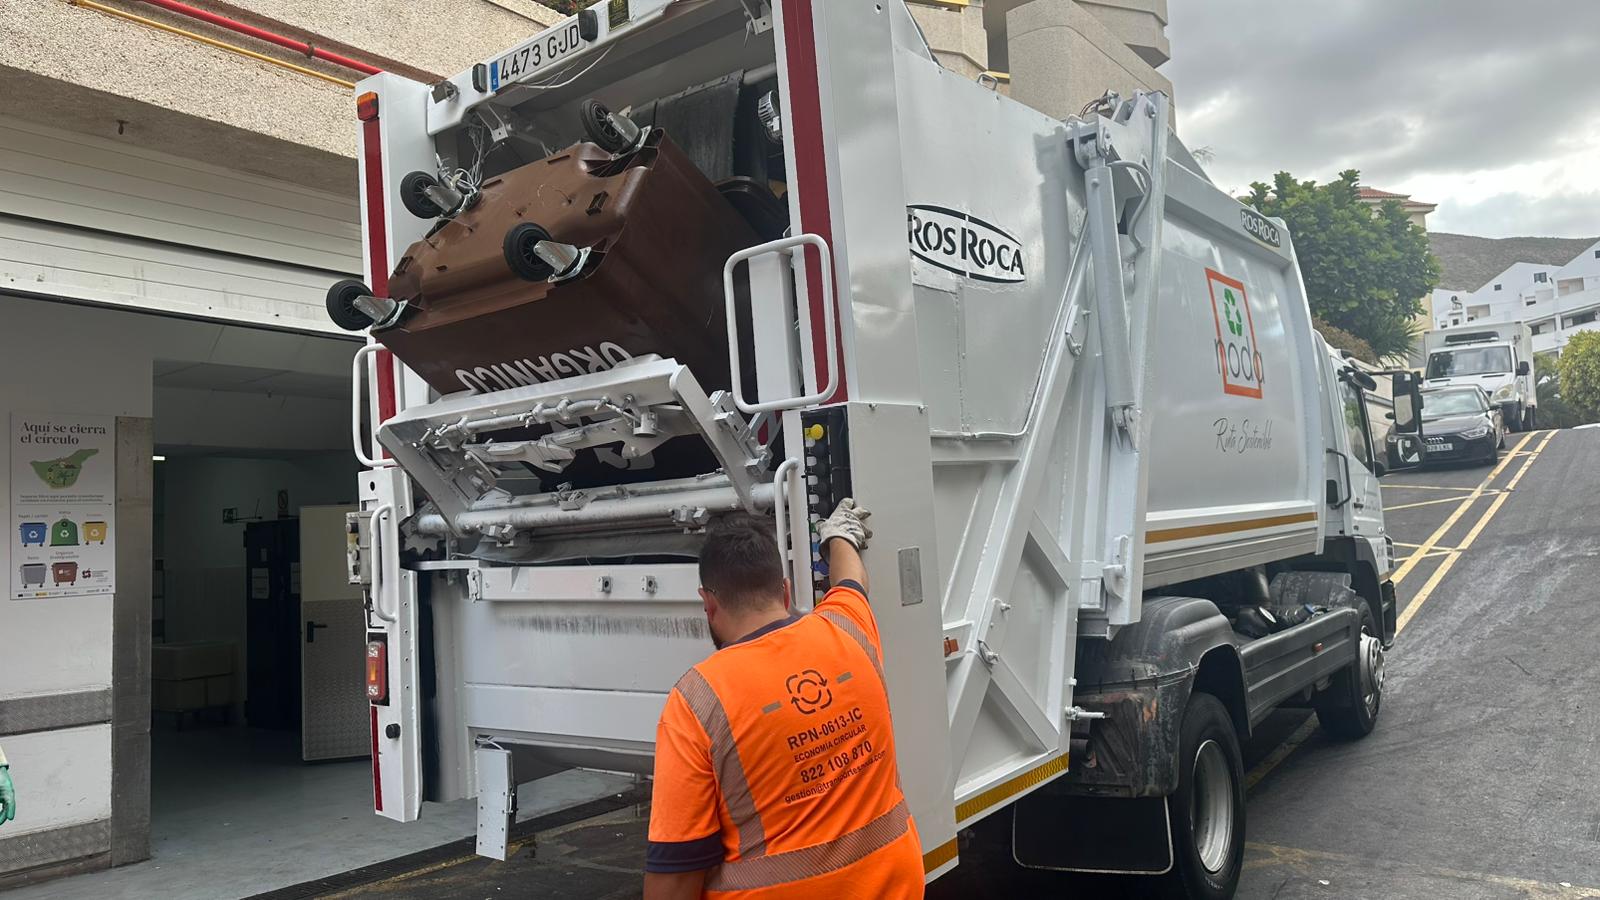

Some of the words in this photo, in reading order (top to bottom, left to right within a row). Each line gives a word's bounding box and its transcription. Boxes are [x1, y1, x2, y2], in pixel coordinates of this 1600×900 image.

[500, 44, 542, 81] 4473
[547, 24, 580, 59] GJD
[20, 434, 31, 444] el
[35, 432, 79, 445] círculo
[21, 421, 50, 435] Aquí
[53, 424, 66, 433] se
[69, 423, 106, 435] cierra
[787, 707, 863, 750] RPN-0613-IC
[833, 724, 867, 747] CIRCULAR
[800, 763, 825, 783] 822
[827, 752, 850, 772] 108
[852, 740, 872, 760] 870
